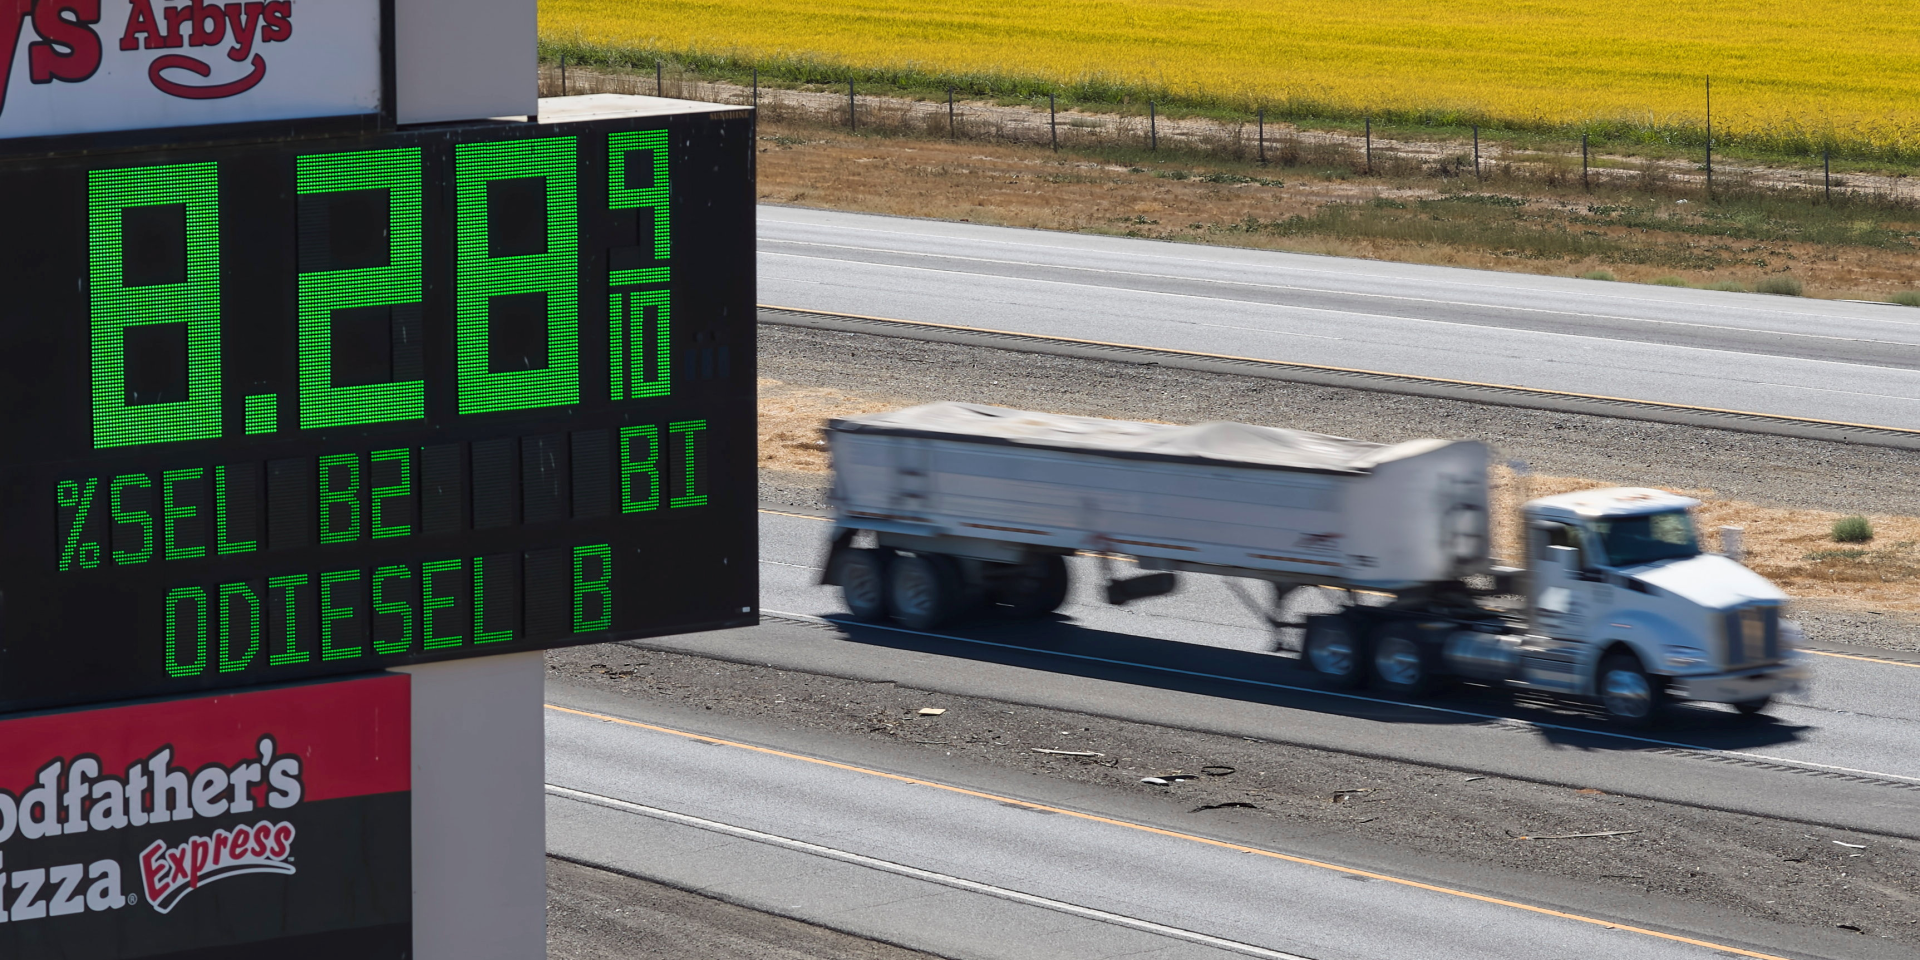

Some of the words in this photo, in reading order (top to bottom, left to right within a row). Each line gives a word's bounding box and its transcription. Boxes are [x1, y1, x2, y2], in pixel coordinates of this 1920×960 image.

[119, 0, 293, 62] Arbys
[608, 128, 671, 260] 9
[88, 135, 580, 449] 8.28
[609, 289, 672, 401] 10
[57, 465, 257, 572] %SEL
[620, 419, 708, 514] BI
[574, 543, 612, 633] B
[140, 822, 295, 905] Express
